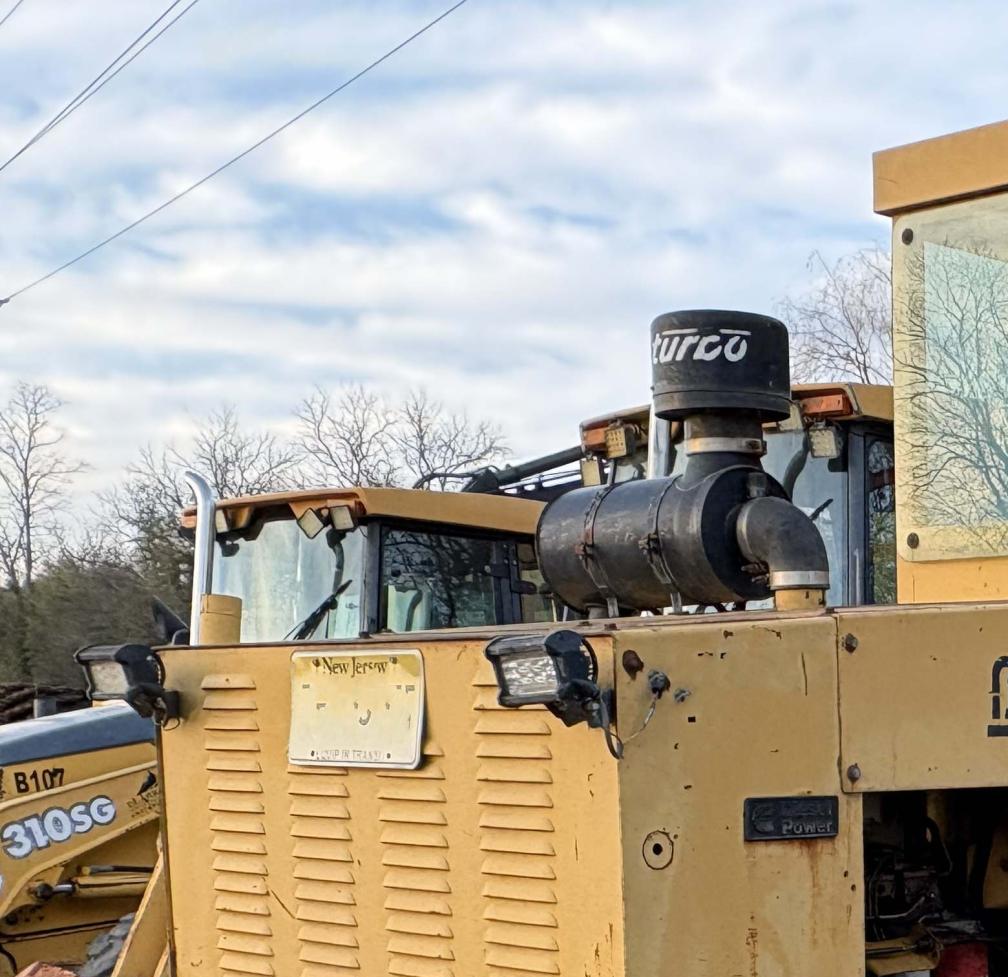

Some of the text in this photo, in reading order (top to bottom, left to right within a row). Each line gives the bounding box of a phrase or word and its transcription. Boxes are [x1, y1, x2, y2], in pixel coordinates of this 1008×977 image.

[321, 656, 349, 675] New
[14, 768, 64, 793] B107
[2, 797, 116, 858] 310SG
[782, 820, 832, 834] Power
